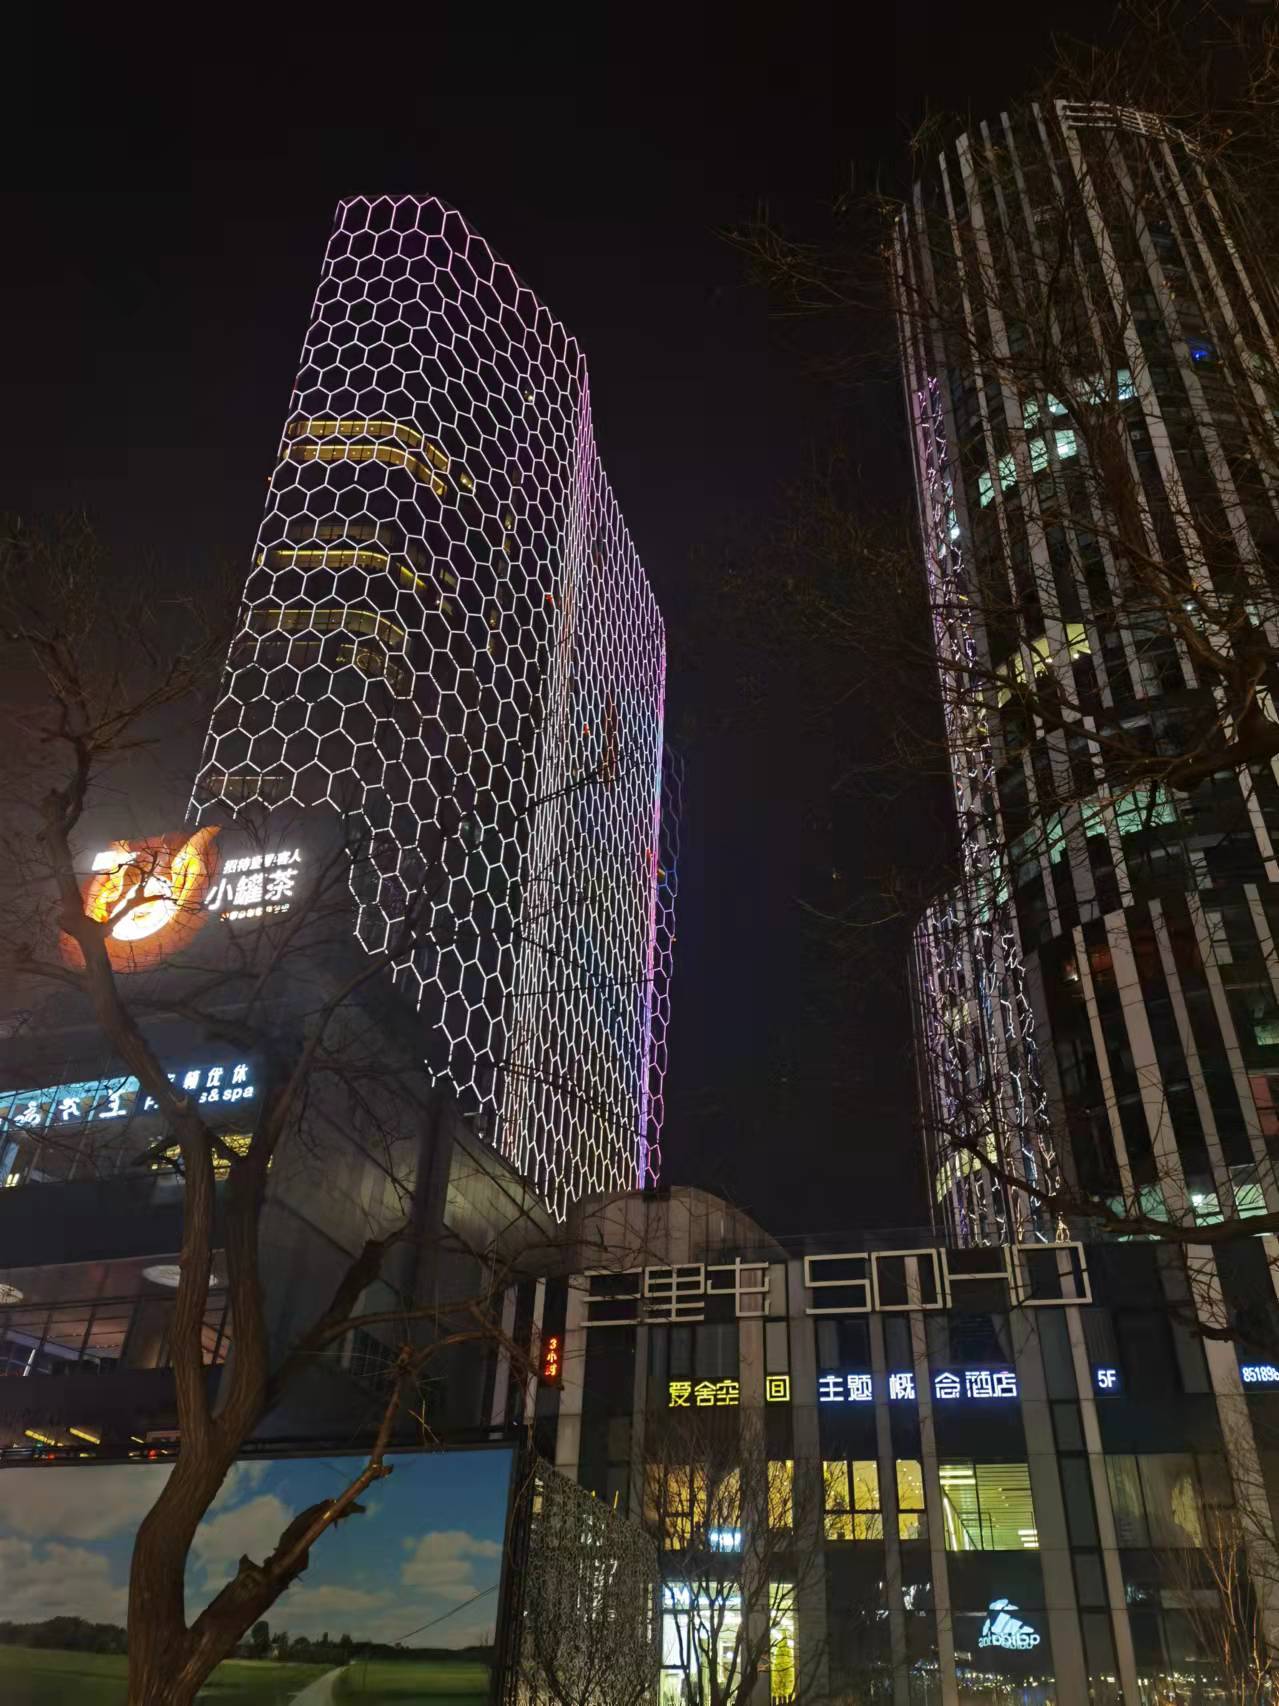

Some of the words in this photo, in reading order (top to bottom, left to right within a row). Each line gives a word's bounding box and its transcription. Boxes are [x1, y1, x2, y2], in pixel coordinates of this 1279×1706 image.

[204, 867, 298, 910] 小罐茶
[222, 1086, 254, 1103] spa
[579, 1257, 770, 1327] 三里屯
[804, 1241, 1092, 1315] SOHO
[1097, 1369, 1117, 1388] 5F
